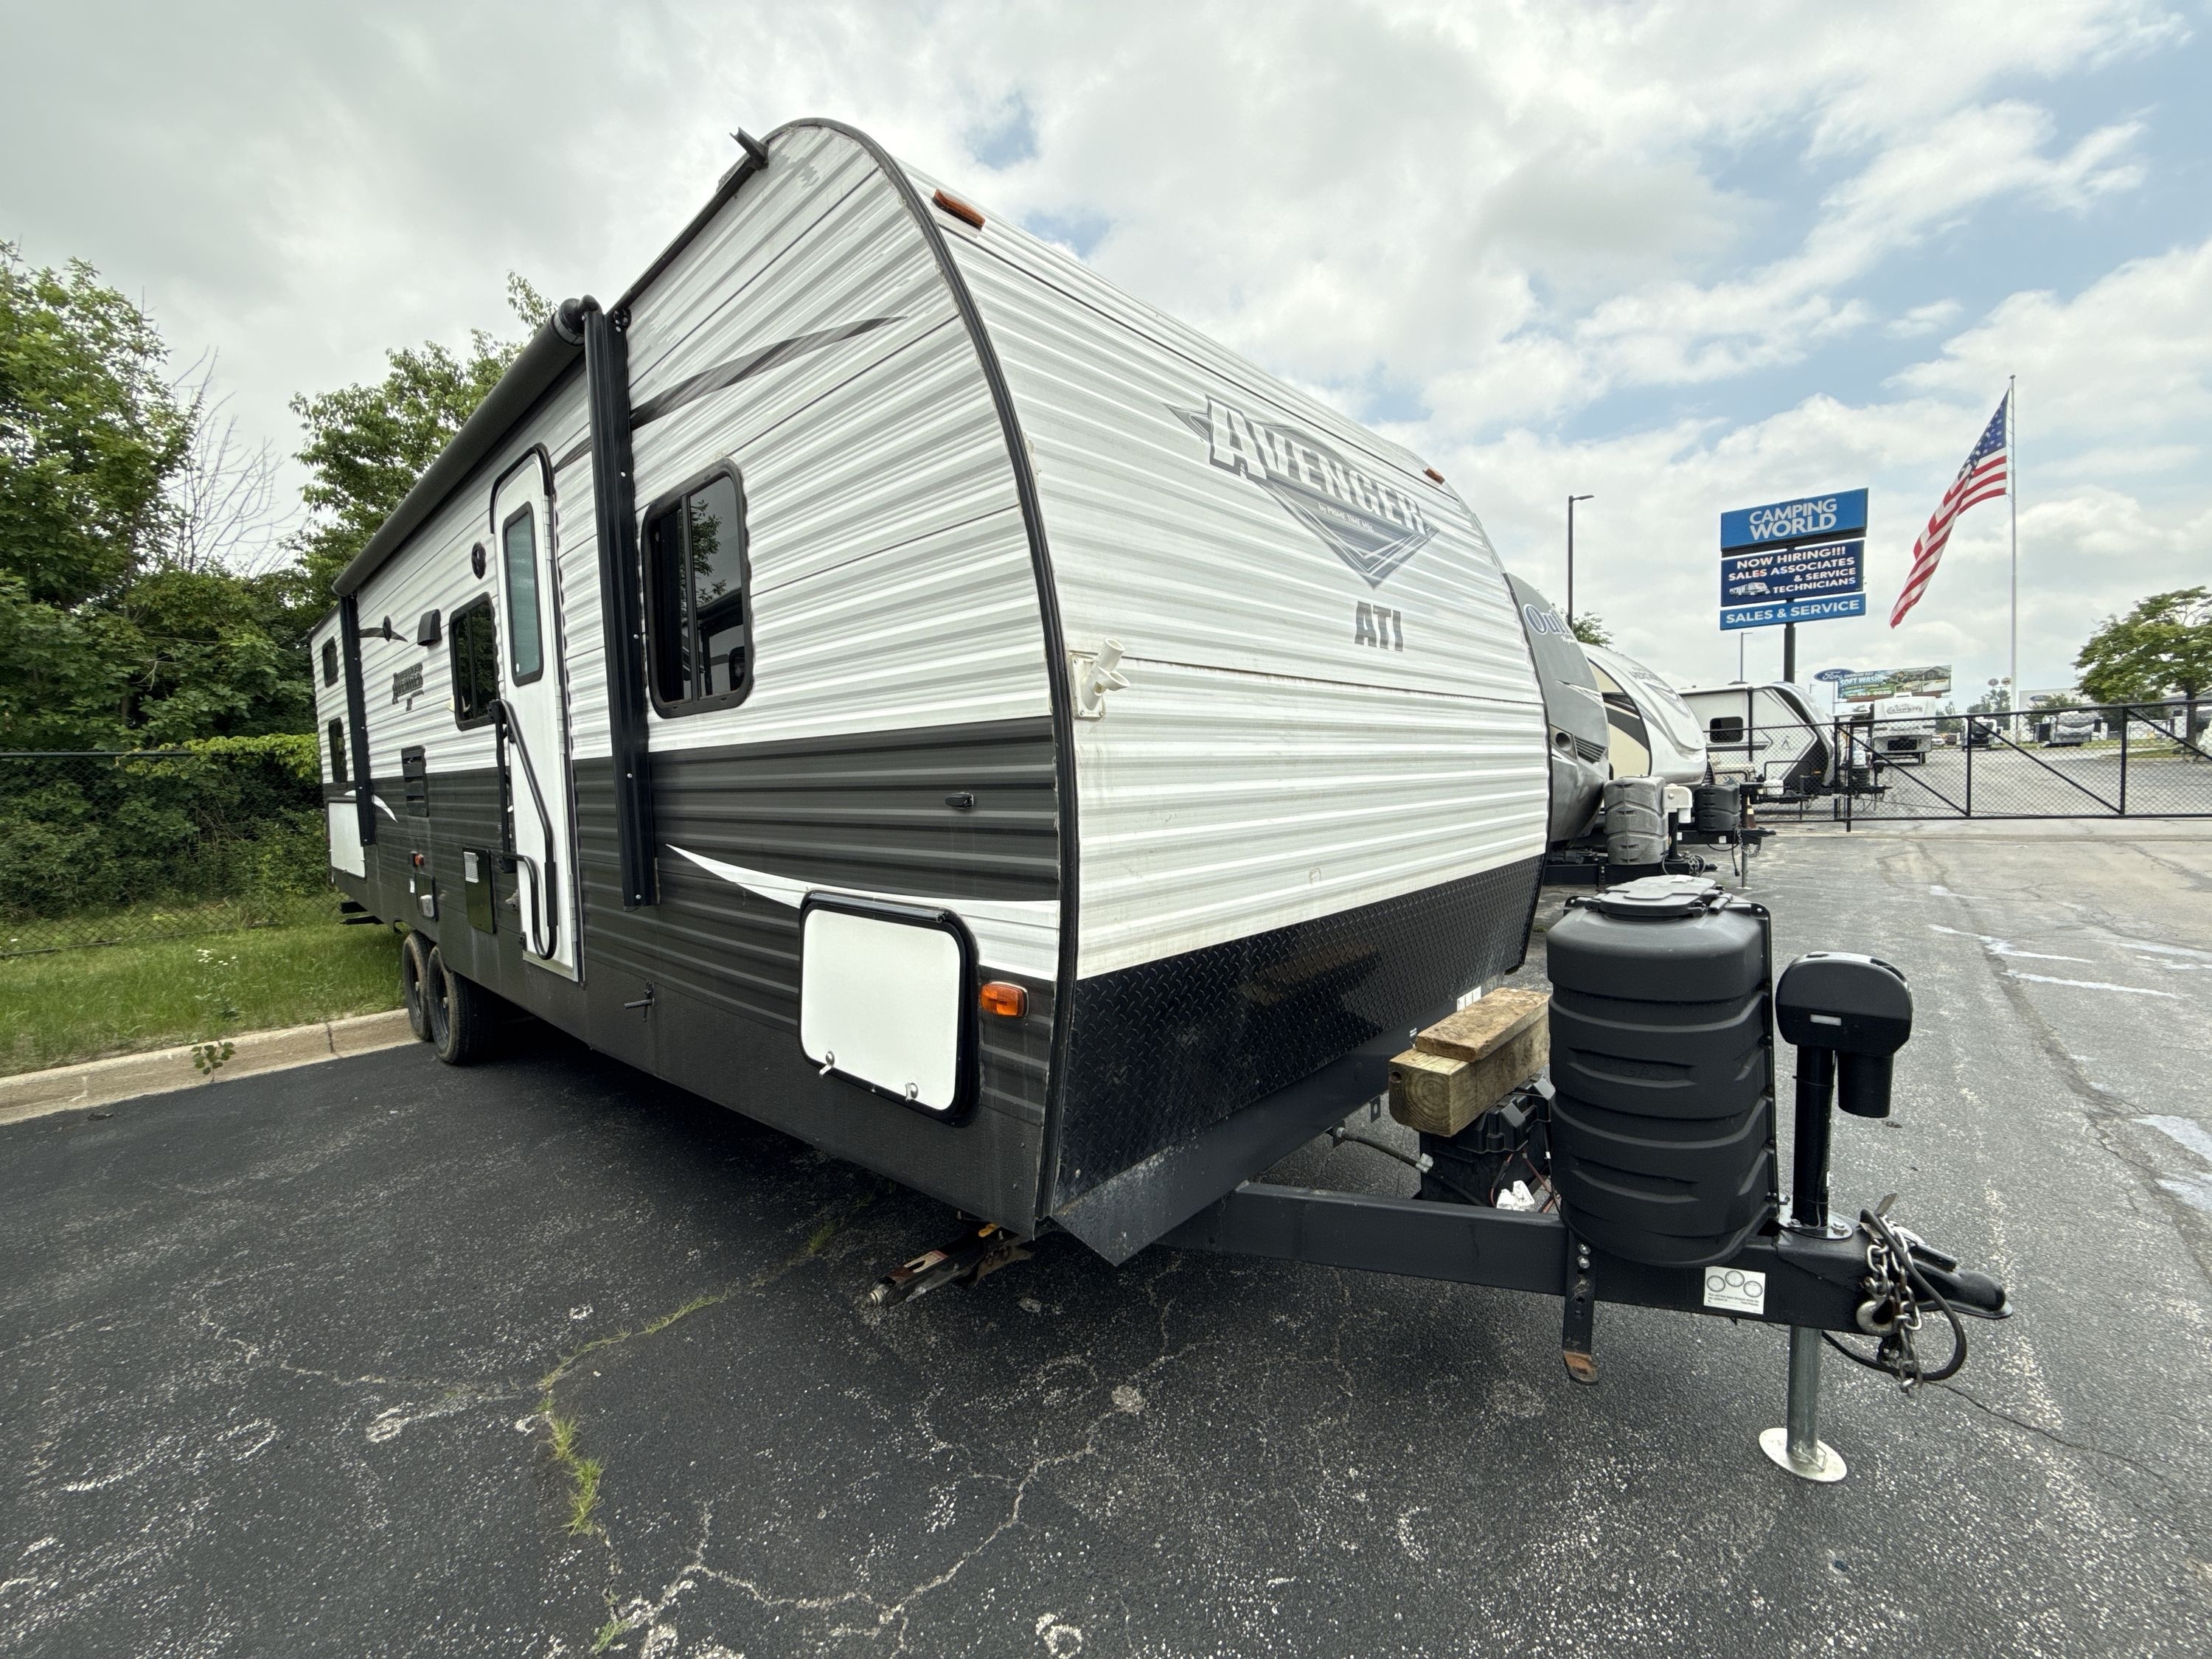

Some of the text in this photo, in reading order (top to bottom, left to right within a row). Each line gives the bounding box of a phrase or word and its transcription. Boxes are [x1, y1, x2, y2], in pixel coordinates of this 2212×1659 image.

[1207, 395, 1430, 537] AVENGER
[1327, 506, 1346, 520] PRIME
[1347, 514, 1362, 526] TIME
[1749, 498, 1837, 525] CAMPING
[1749, 513, 1837, 541] WORLD
[1728, 557, 1855, 581] SALES ASSOCIATES
[1736, 546, 1846, 569] NOW HIRING!!!
[1773, 577, 1856, 594] TECHNICIANS
[1793, 568, 1856, 582] & SERVICE
[1726, 599, 1860, 624] SALES & SERVICE
[1354, 600, 1404, 652] ATI
[1840, 678, 1857, 686] SOFT
